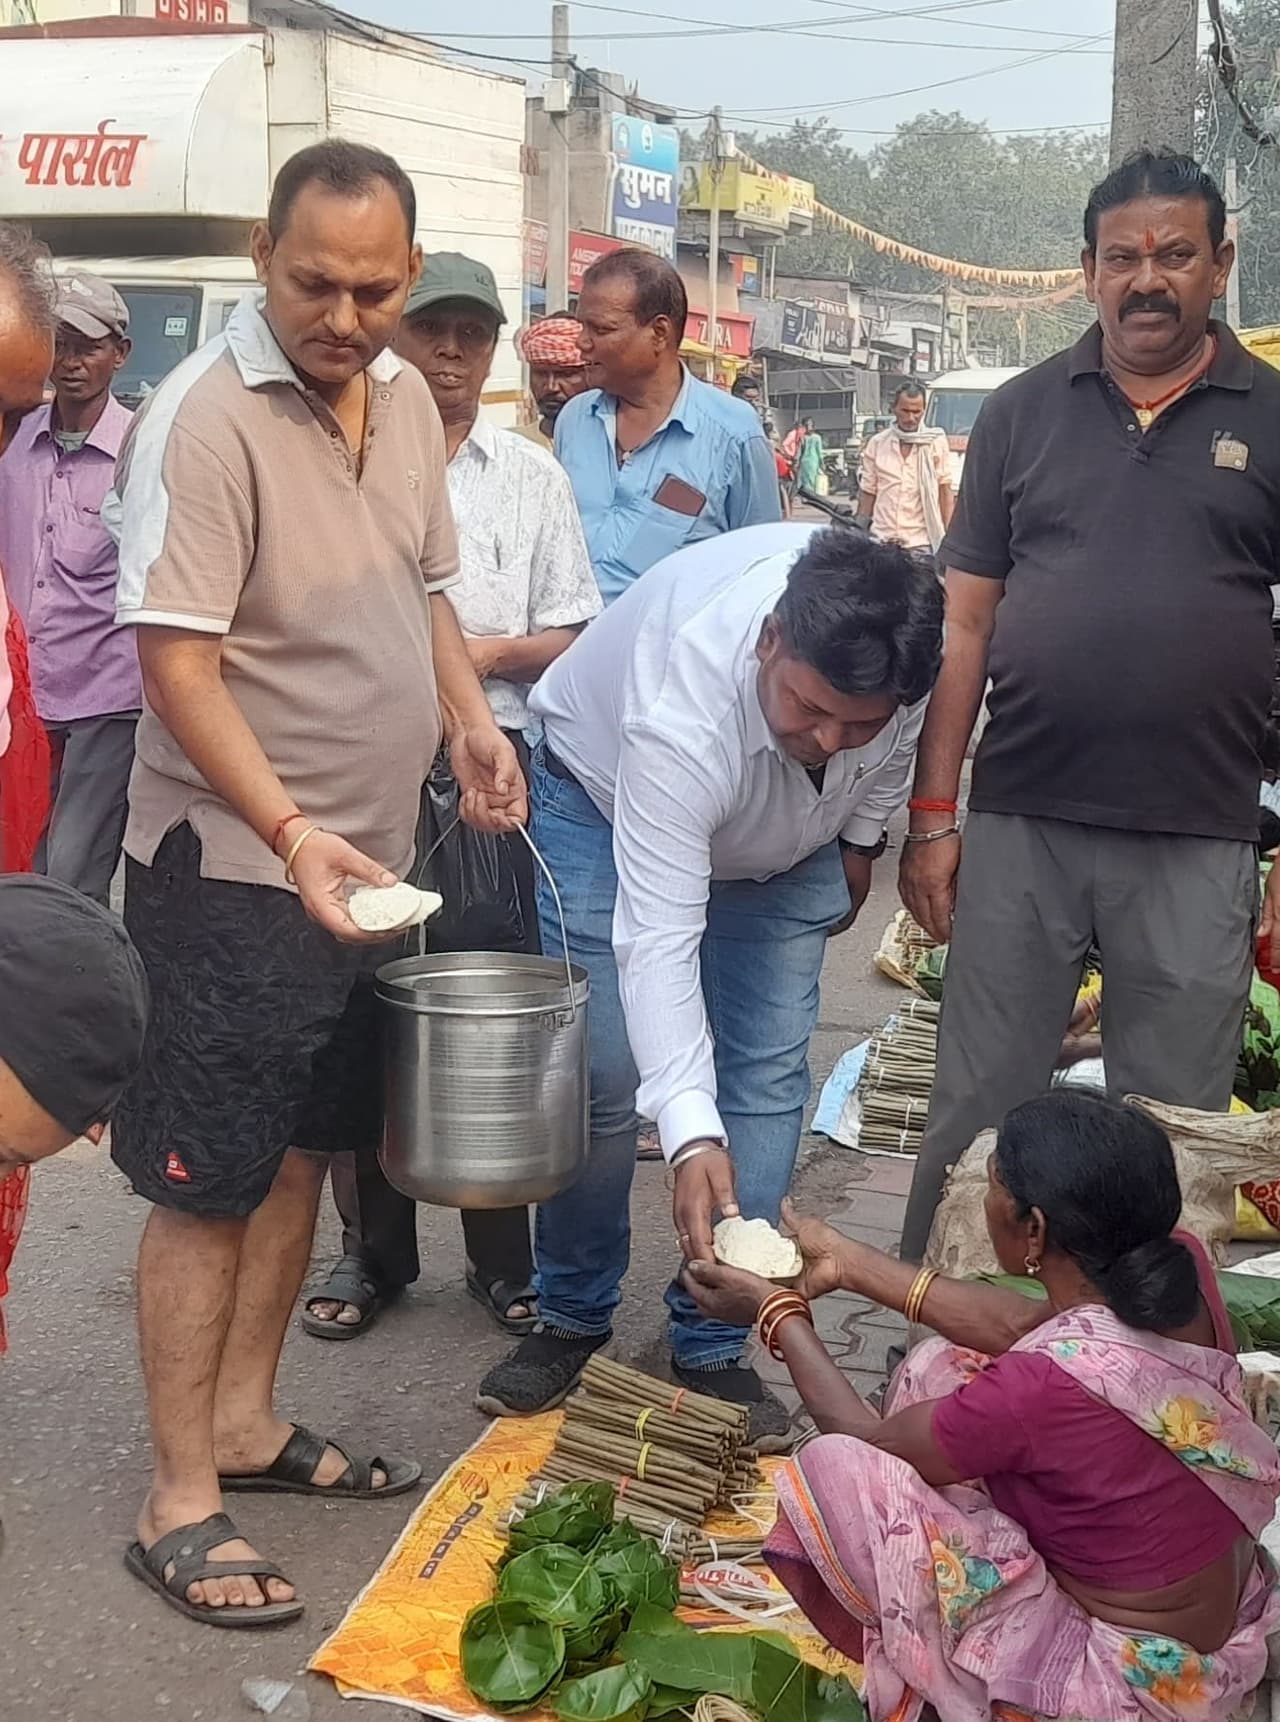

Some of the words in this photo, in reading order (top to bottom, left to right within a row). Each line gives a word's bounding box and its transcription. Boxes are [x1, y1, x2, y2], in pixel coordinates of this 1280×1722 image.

[18, 119, 148, 188] पार्सल
[618, 163, 673, 209] सुमन
[698, 320, 733, 348] ZRA
